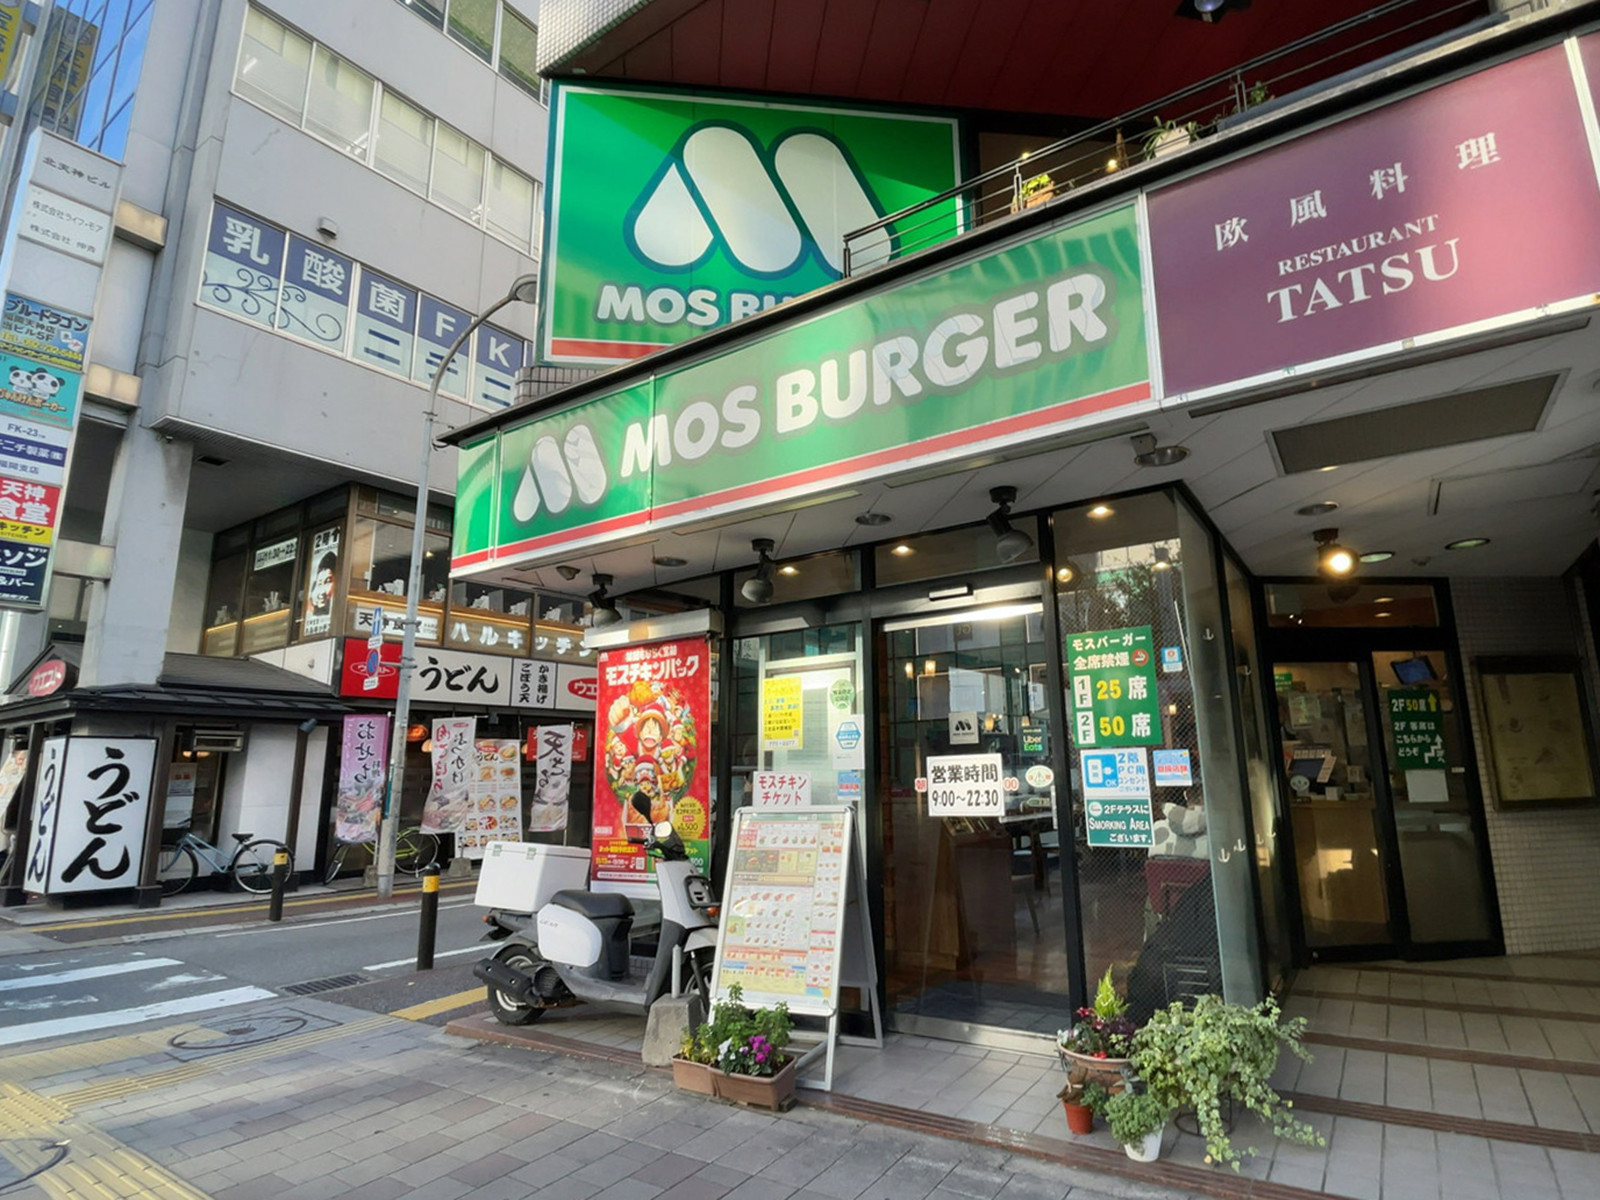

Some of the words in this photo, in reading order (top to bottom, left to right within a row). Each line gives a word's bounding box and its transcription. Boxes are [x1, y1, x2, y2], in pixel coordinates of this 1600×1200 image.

[42, 156, 111, 189] 北天神ビル
[1214, 132, 1501, 251] 欧風料理
[1277, 213, 1439, 276] RESTAURANT
[1266, 237, 1461, 324] TATSU
[6, 299, 88, 332] ブルードラゴン
[597, 285, 720, 327] MOS
[731, 292, 795, 323] B
[620, 384, 761, 479] MOS
[775, 272, 1108, 434] BURGER
[7, 423, 38, 438] FK-23
[2, 479, 46, 501] 天神
[0, 496, 51, 526] 食堂
[1072, 633, 1146, 651] モスバーガー
[419, 656, 499, 694] うどん
[606, 655, 698, 686] モスチキンパック
[1073, 652, 1130, 671] 全席禁煙
[536, 665, 549, 704] かき揚げ
[1096, 680, 1122, 699] 25
[1128, 675, 1147, 700] 席
[1099, 716, 1125, 736] 50
[1131, 712, 1151, 737] 席
[1023, 736, 1042, 744] Uber
[758, 775, 808, 789] モスチキン
[932, 763, 999, 784] 営業時間
[1118, 777, 1147, 785] コンセント
[761, 791, 802, 806] チケット
[1104, 804, 1150, 815] 2Fテラスに
[27, 747, 56, 883] うどん
[62, 746, 140, 884] うどん
[1129, 817, 1150, 831] AREA
